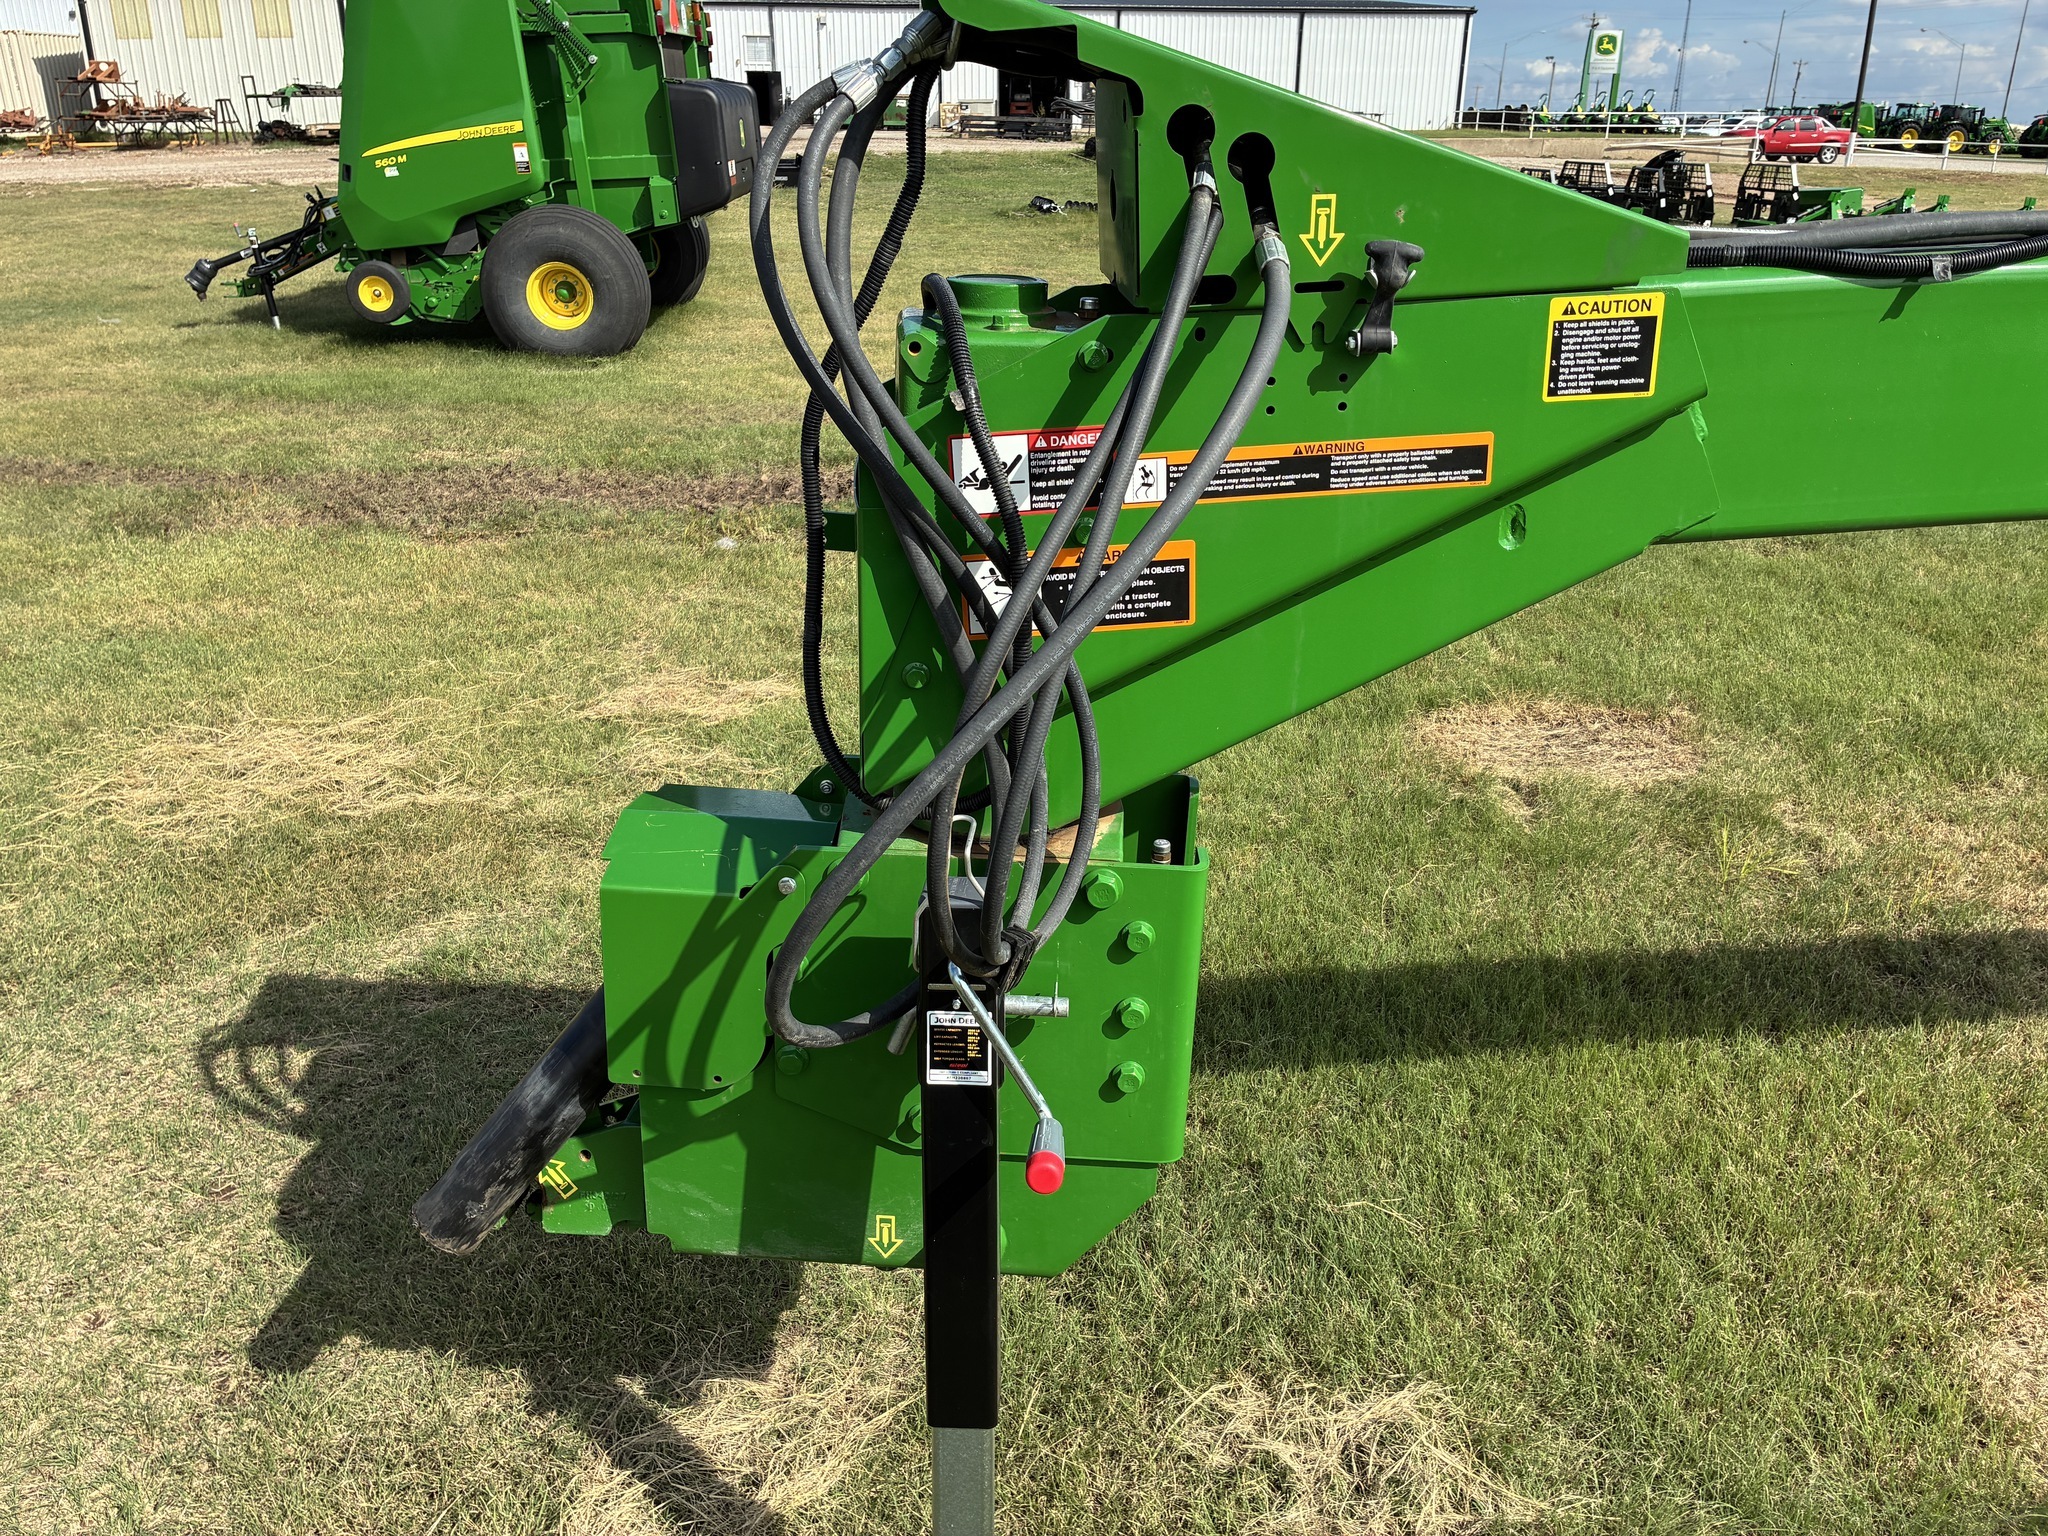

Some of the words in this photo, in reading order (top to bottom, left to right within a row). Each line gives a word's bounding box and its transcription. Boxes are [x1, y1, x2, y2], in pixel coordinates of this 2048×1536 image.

[458, 128, 482, 139] JOHN
[484, 124, 516, 136] DEERE
[375, 156, 396, 168] 560
[397, 154, 407, 164] M
[1578, 298, 1652, 315] CAUTION
[1562, 328, 1594, 336] Disengage
[1581, 342, 1608, 350] servicing
[1304, 442, 1365, 455] WARNING
[1030, 450, 1070, 460] Entanglement
[1030, 458, 1055, 466] driveline
[1349, 466, 1373, 474] transport
[1031, 480, 1046, 488] Keep
[1032, 493, 1048, 501] Avoid
[1032, 500, 1054, 509] rotating
[1046, 572, 1068, 581] AVOID
[1151, 565, 1184, 573] OBJECTS
[1131, 578, 1155, 587] place.
[1132, 591, 1159, 599] tractor
[1093, 599, 1106, 613] ISO
[1134, 600, 1170, 610] complete
[1105, 611, 1147, 619] enclosure.
[1017, 662, 1050, 697] Engineered
[953, 740, 975, 763] Mexico
